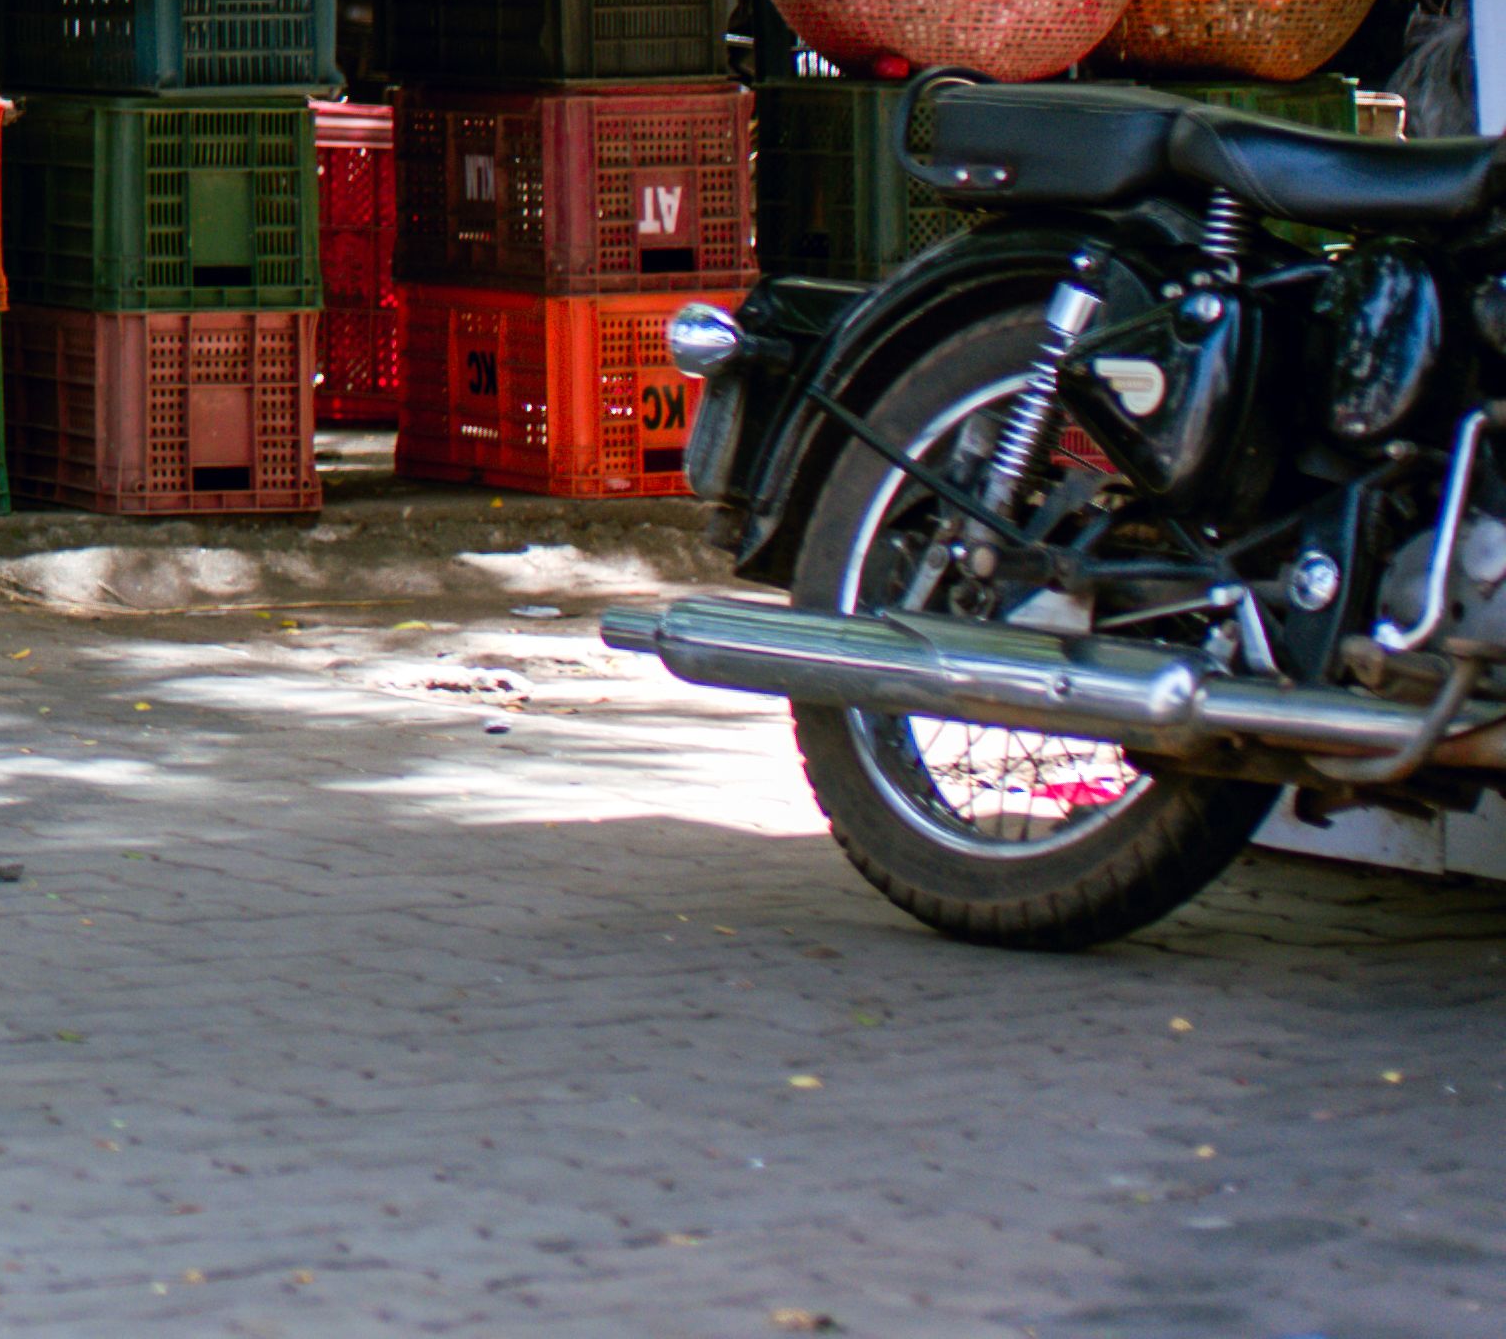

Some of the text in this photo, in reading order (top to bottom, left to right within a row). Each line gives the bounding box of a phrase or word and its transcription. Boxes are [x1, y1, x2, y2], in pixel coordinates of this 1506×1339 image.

[638, 185, 683, 235] AT
[467, 351, 498, 396] KC
[640, 383, 687, 432] KC
